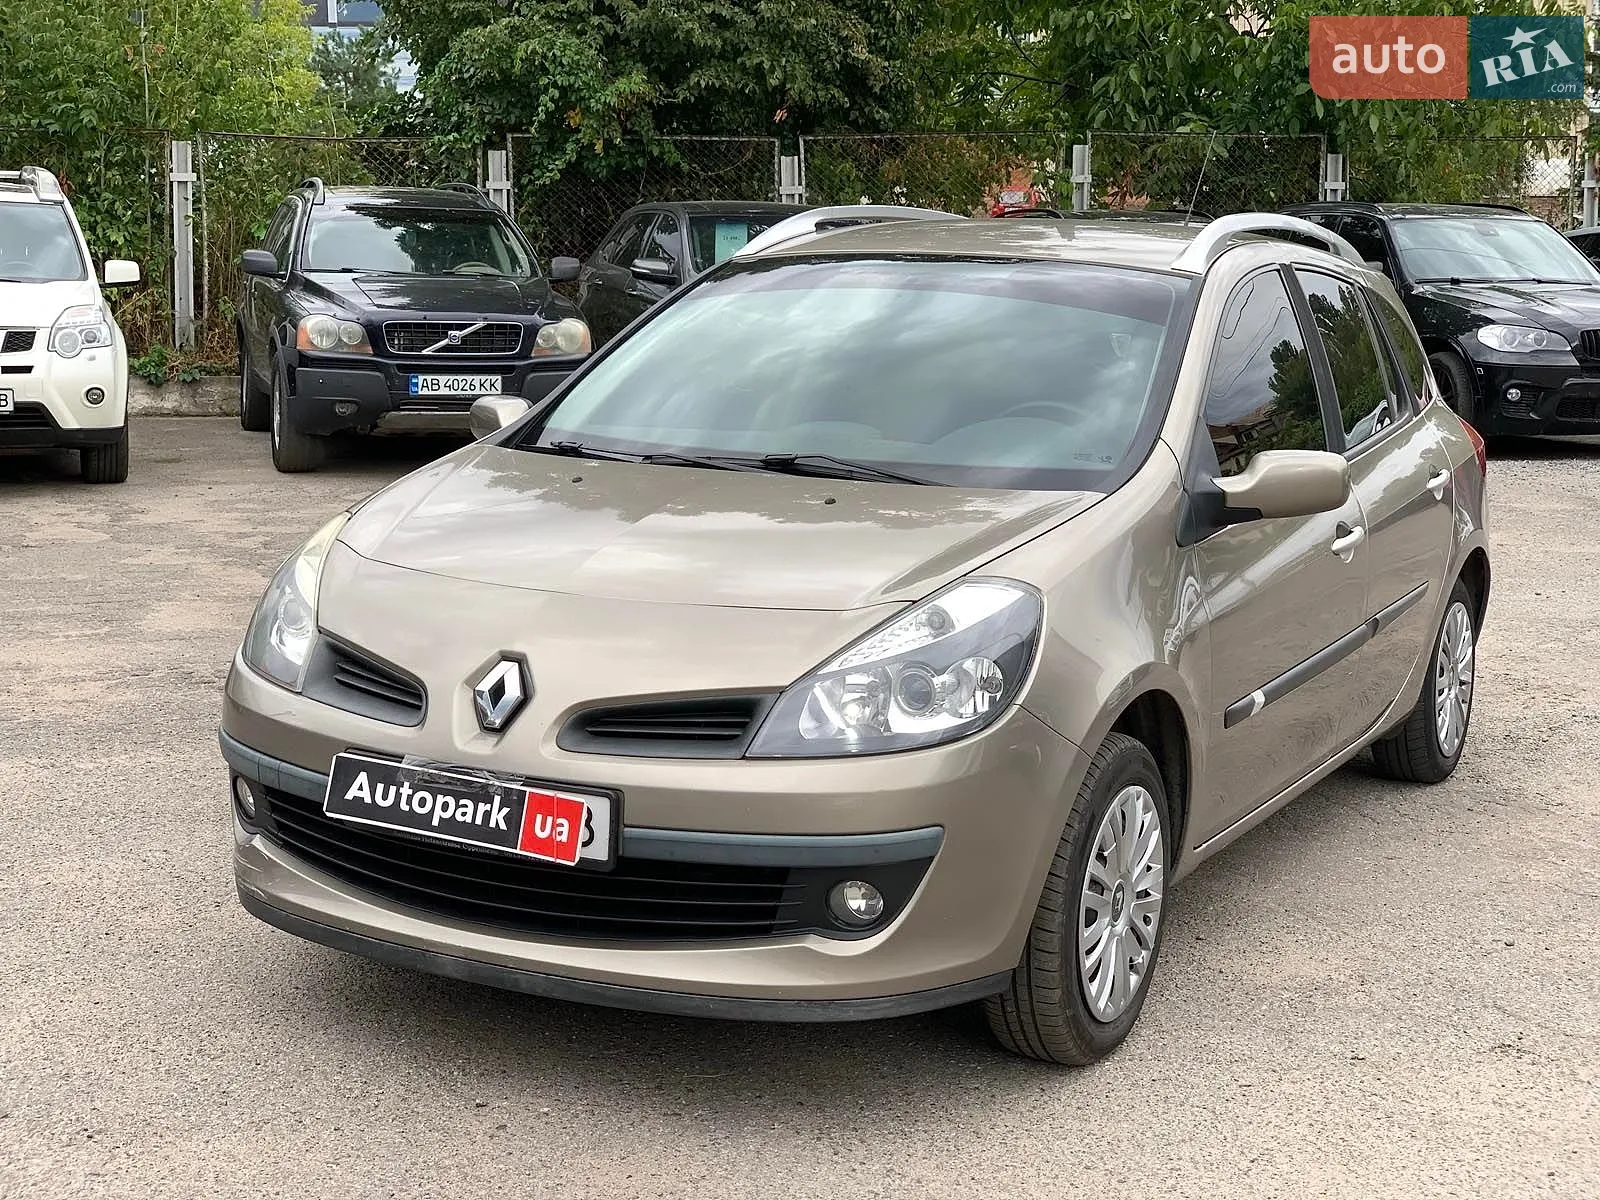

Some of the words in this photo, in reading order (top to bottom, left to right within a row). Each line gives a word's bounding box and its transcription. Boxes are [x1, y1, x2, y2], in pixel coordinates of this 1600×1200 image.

[420, 378, 441, 392] AB
[443, 378, 477, 392] 4026
[479, 378, 500, 392] KK
[343, 771, 511, 831] Autopark
[534, 811, 570, 843] ua
